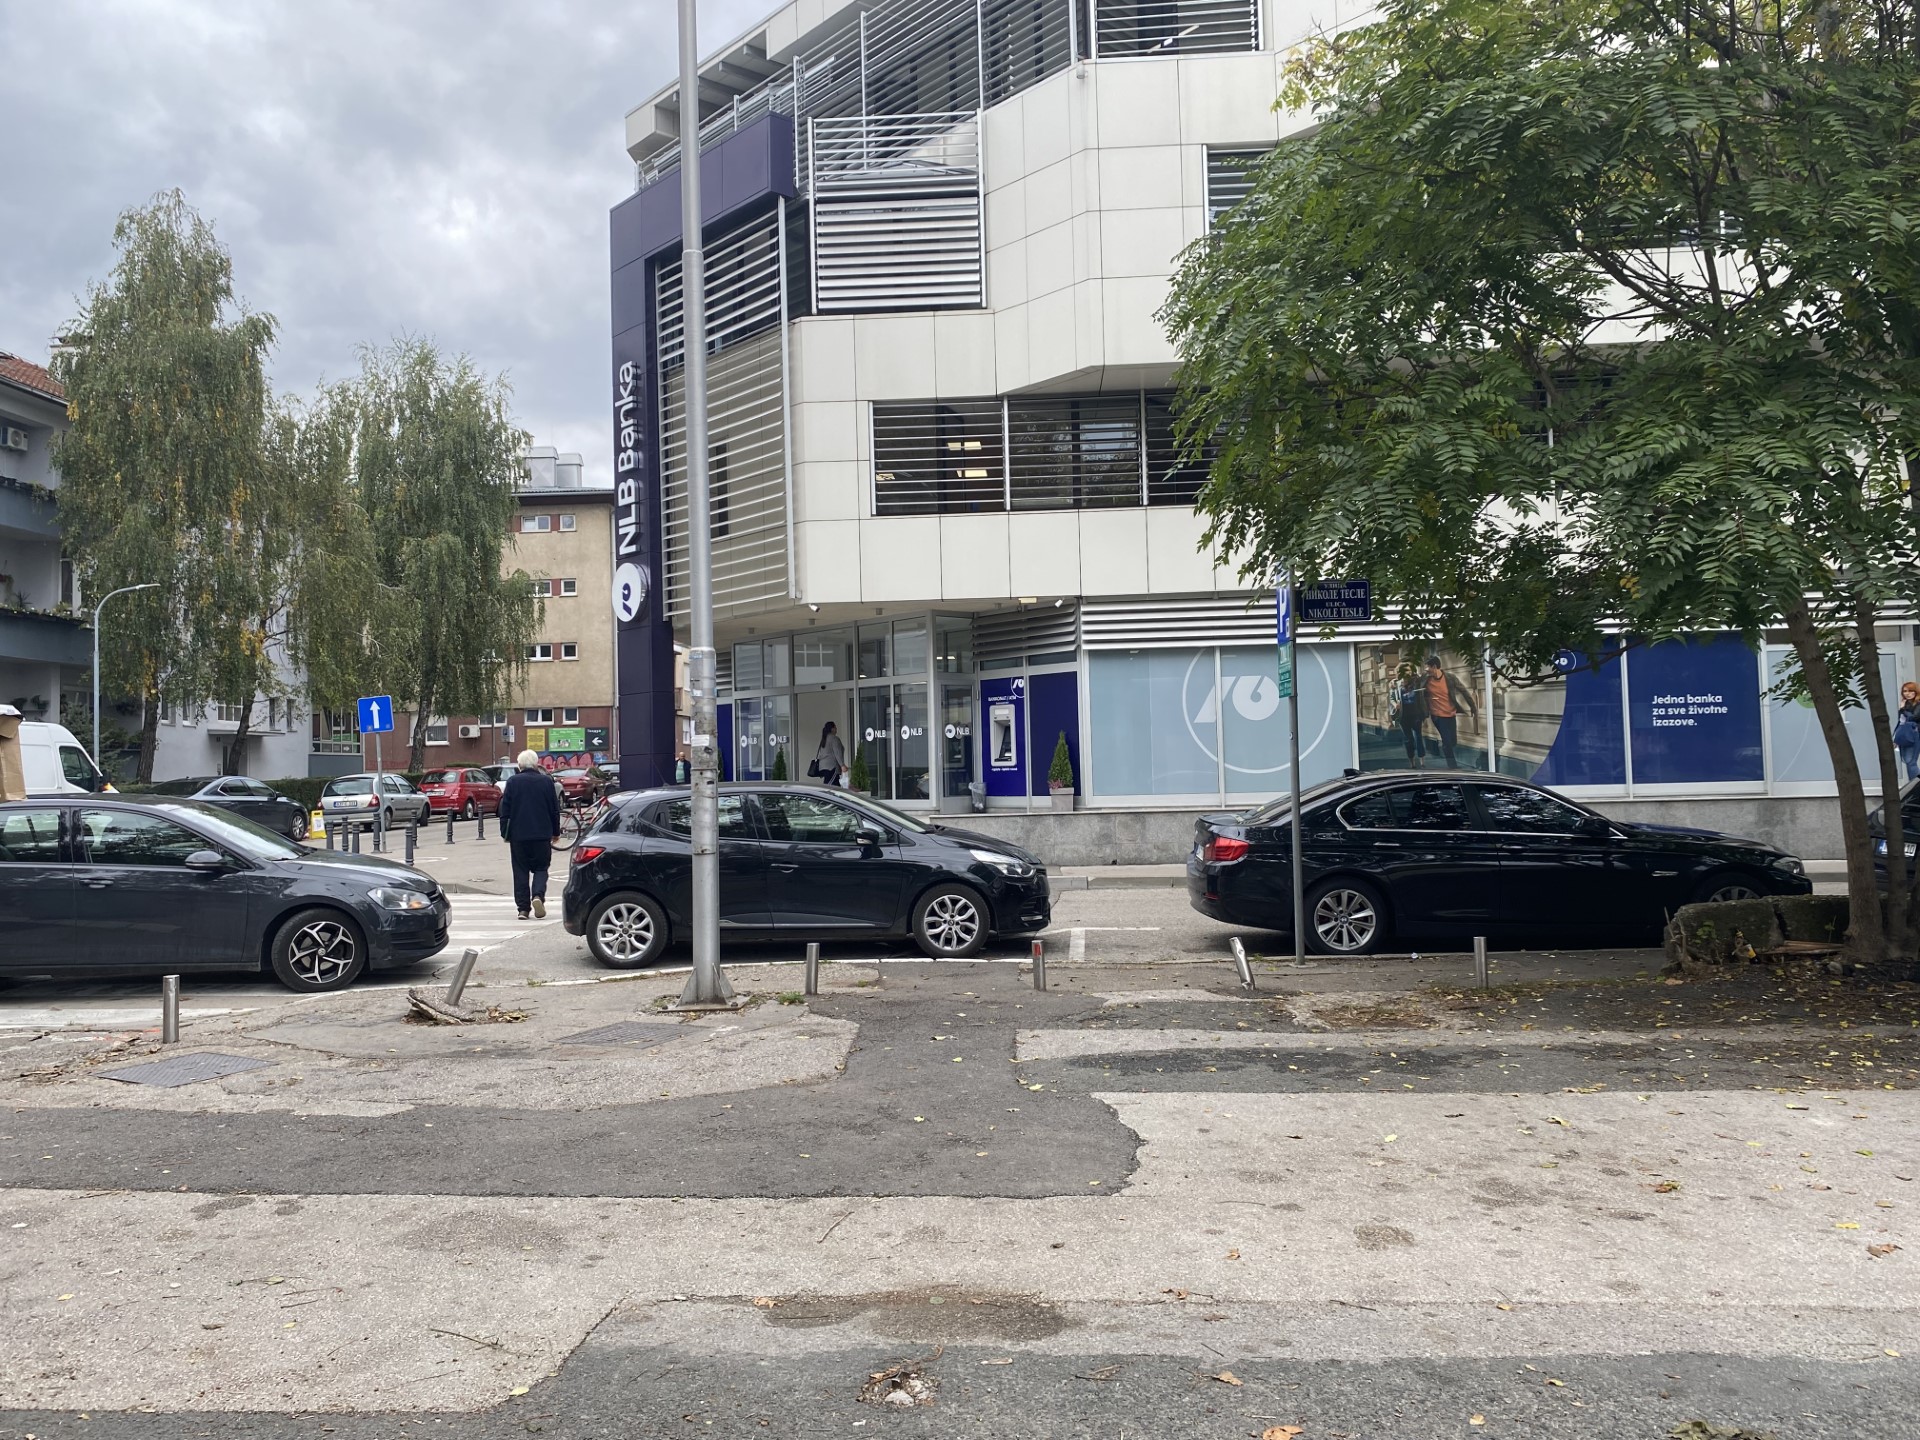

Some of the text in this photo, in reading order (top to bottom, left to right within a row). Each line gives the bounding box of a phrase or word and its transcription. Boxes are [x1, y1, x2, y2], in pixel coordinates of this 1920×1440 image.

[615, 361, 639, 555] NLB Banka
[1340, 588, 1366, 599] ТЕСЛЕ
[1308, 607, 1365, 618] NIKOLE TESLE
[1652, 693, 1723, 704] Jedna banka
[1652, 705, 1728, 715] za sve životne
[1652, 717, 1698, 726] izazove.
[874, 729, 887, 738] NLB
[910, 727, 923, 736] NLB
[956, 727, 970, 735] NLB
